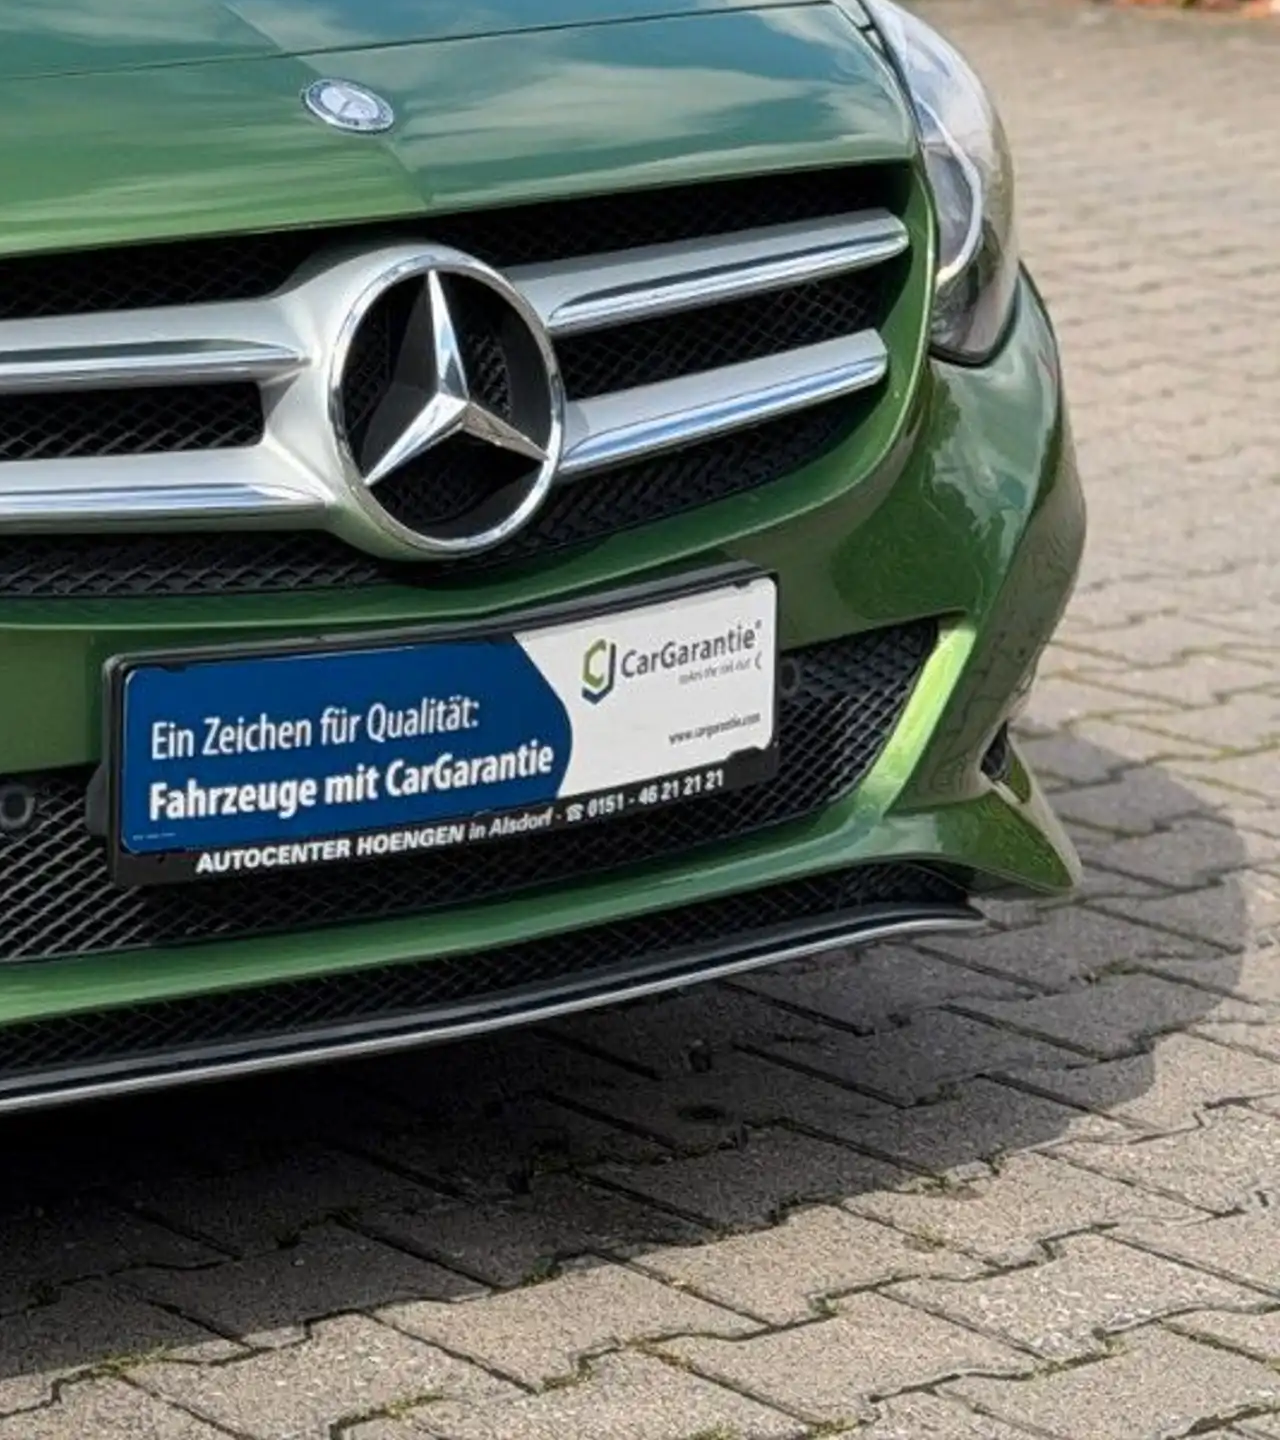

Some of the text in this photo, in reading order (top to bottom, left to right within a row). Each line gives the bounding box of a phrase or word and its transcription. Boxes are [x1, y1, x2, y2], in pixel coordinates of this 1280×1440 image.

[620, 624, 756, 678] CarGarantie
[151, 694, 481, 760] Ein Zeichen für Qualität:
[149, 739, 555, 822] Fahrzeuge mit CarGarantie
[195, 838, 351, 874] AUTOCENTER
[356, 823, 466, 857] HOENGEN
[468, 822, 487, 841] in
[490, 806, 554, 838] Alsdorf
[587, 793, 625, 812] 0151
[660, 779, 681, 800] 21
[683, 774, 703, 795] 21
[704, 768, 725, 790] 21
